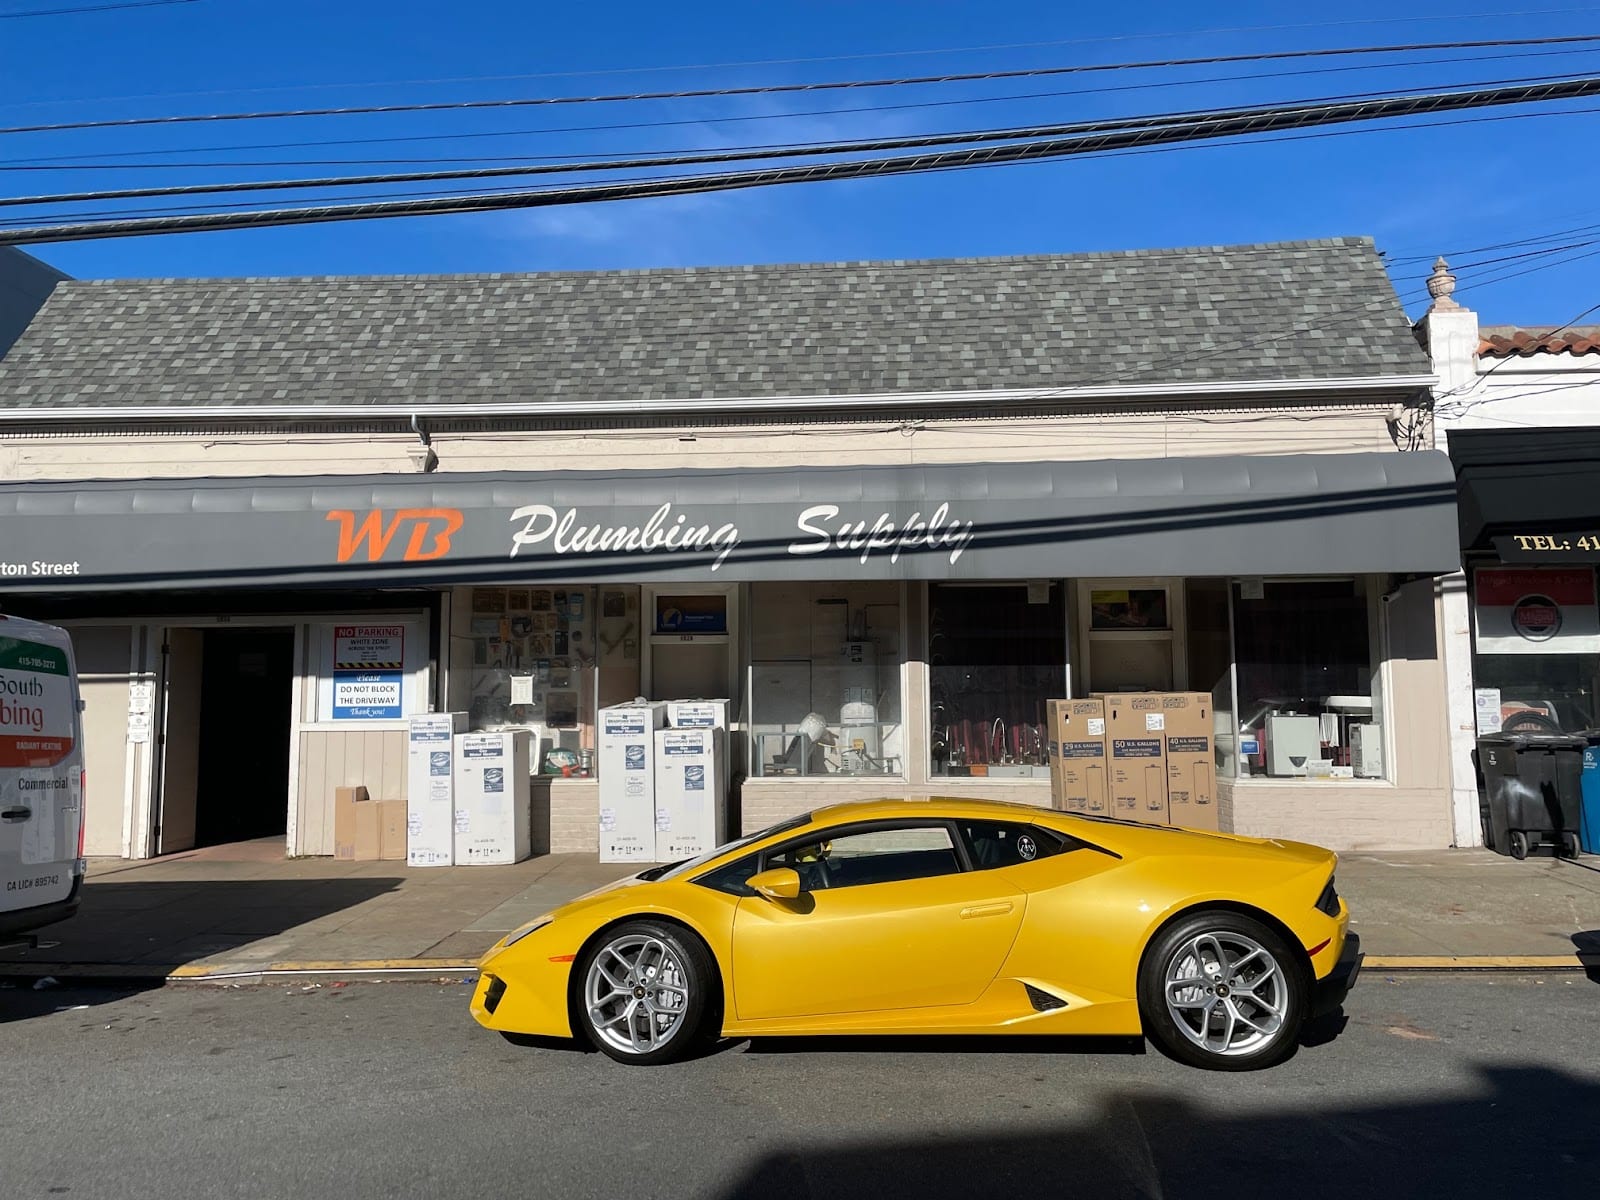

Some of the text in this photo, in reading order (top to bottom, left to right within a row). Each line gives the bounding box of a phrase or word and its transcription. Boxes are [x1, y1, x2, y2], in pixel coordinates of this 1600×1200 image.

[326, 502, 974, 571] WB Plumbing Supply
[1513, 535, 1571, 551] TEL:
[0, 560, 80, 576] ton Street
[339, 627, 400, 637] NO PARKING
[340, 685, 396, 693] DO NOT BLOCK
[340, 696, 396, 705] THE DRIVEWAY
[1115, 740, 1126, 749] 50
[18, 776, 68, 791] Commercial
[7, 880, 17, 891] CA
